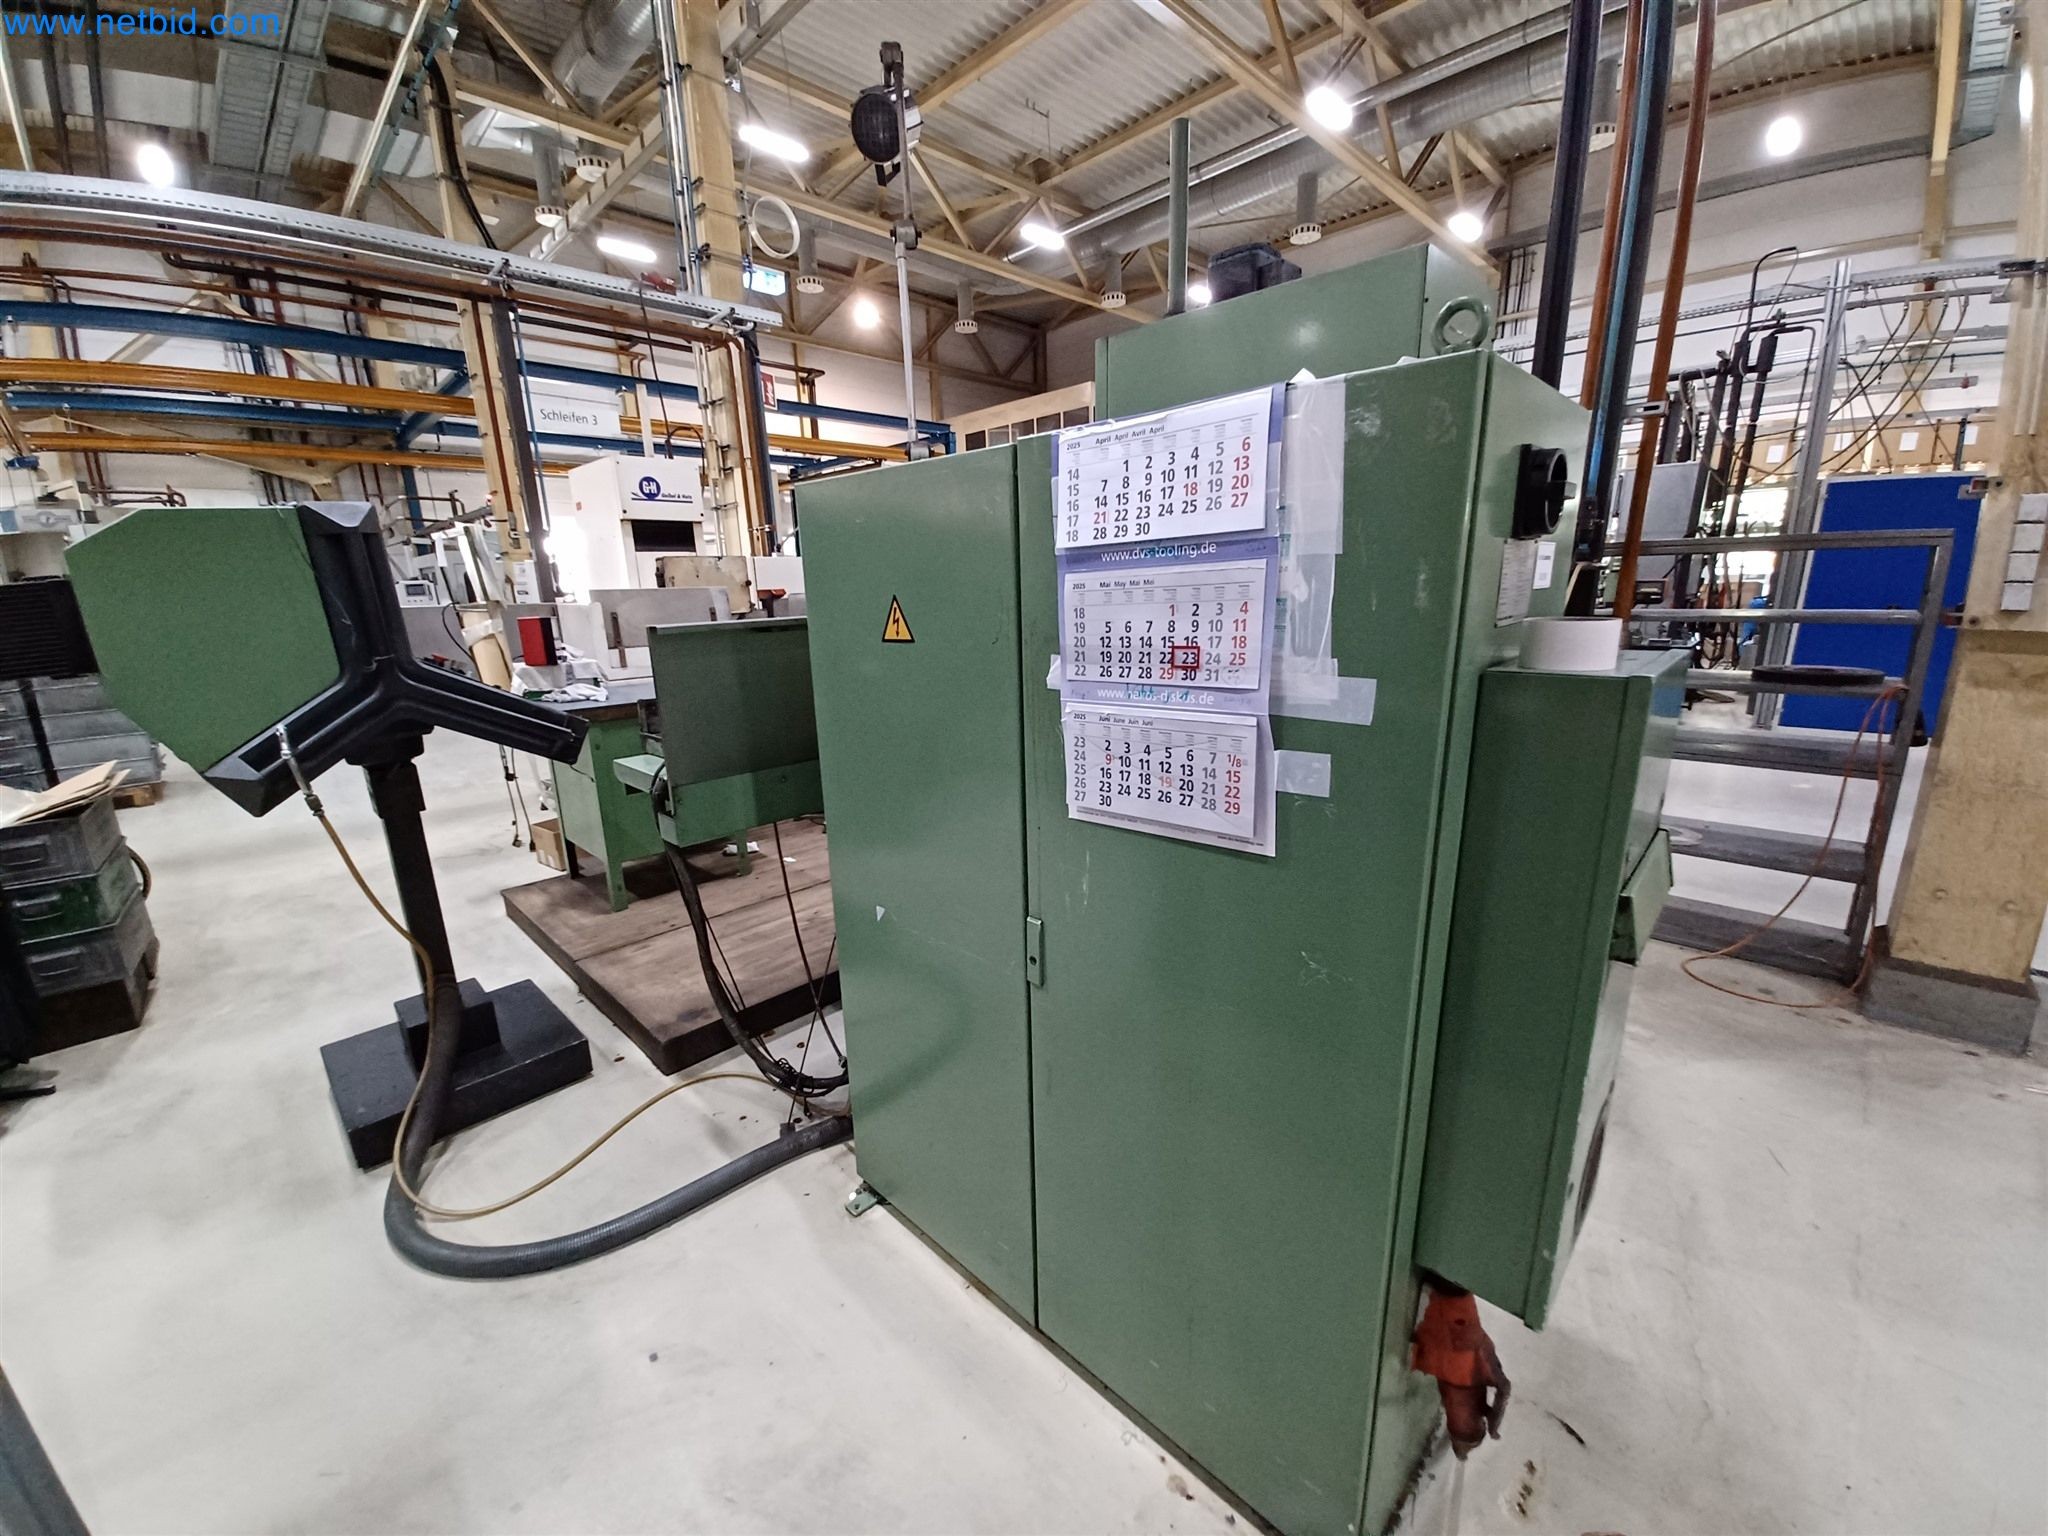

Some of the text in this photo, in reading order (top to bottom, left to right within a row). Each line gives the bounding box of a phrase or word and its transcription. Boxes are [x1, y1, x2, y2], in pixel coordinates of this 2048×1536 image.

[540, 409, 598, 426] Schleifen 3
[1067, 425, 1164, 450] 2025 April April Avril April
[1067, 436, 1251, 480] 14 1 2 3 4 5 6
[1067, 455, 1250, 496] 15 7 8 9 10 11 12 13
[1067, 474, 1249, 512] 16 14 15 16 17 18 19 20
[1067, 492, 1248, 527] 17 21 22 23 24 25 26 27
[1066, 522, 1150, 542] 18 28 29 30
[1101, 541, 1217, 562] www.dvs-tooling.de
[1074, 601, 1248, 619] 18 1 2 3 4
[1074, 619, 1247, 633] 19 5 6 7 8 9 10 11
[1074, 636, 1247, 649] 20 12 13 14 15 16 17 18
[1075, 651, 1246, 666] 21 19 20 21 22 23 24 25
[1075, 665, 1219, 682] 22 26 27 28 29 30 31
[1099, 715, 1111, 723] Juni
[1074, 736, 1086, 748] 23
[1105, 740, 1111, 751] 2
[1124, 742, 1130, 754] 3
[1144, 744, 1151, 756] 4
[1165, 747, 1172, 759] 5
[1186, 749, 1194, 762] 6
[1209, 752, 1217, 764] 7
[1074, 750, 1241, 783] 24 9 10 11 12 13 14 15
[1074, 763, 1240, 799] 25 16 17 18 19 20 21 22
[1075, 777, 1240, 814] 26 23 24 25 26 27 28 29
[1075, 790, 1112, 807] 27 30
